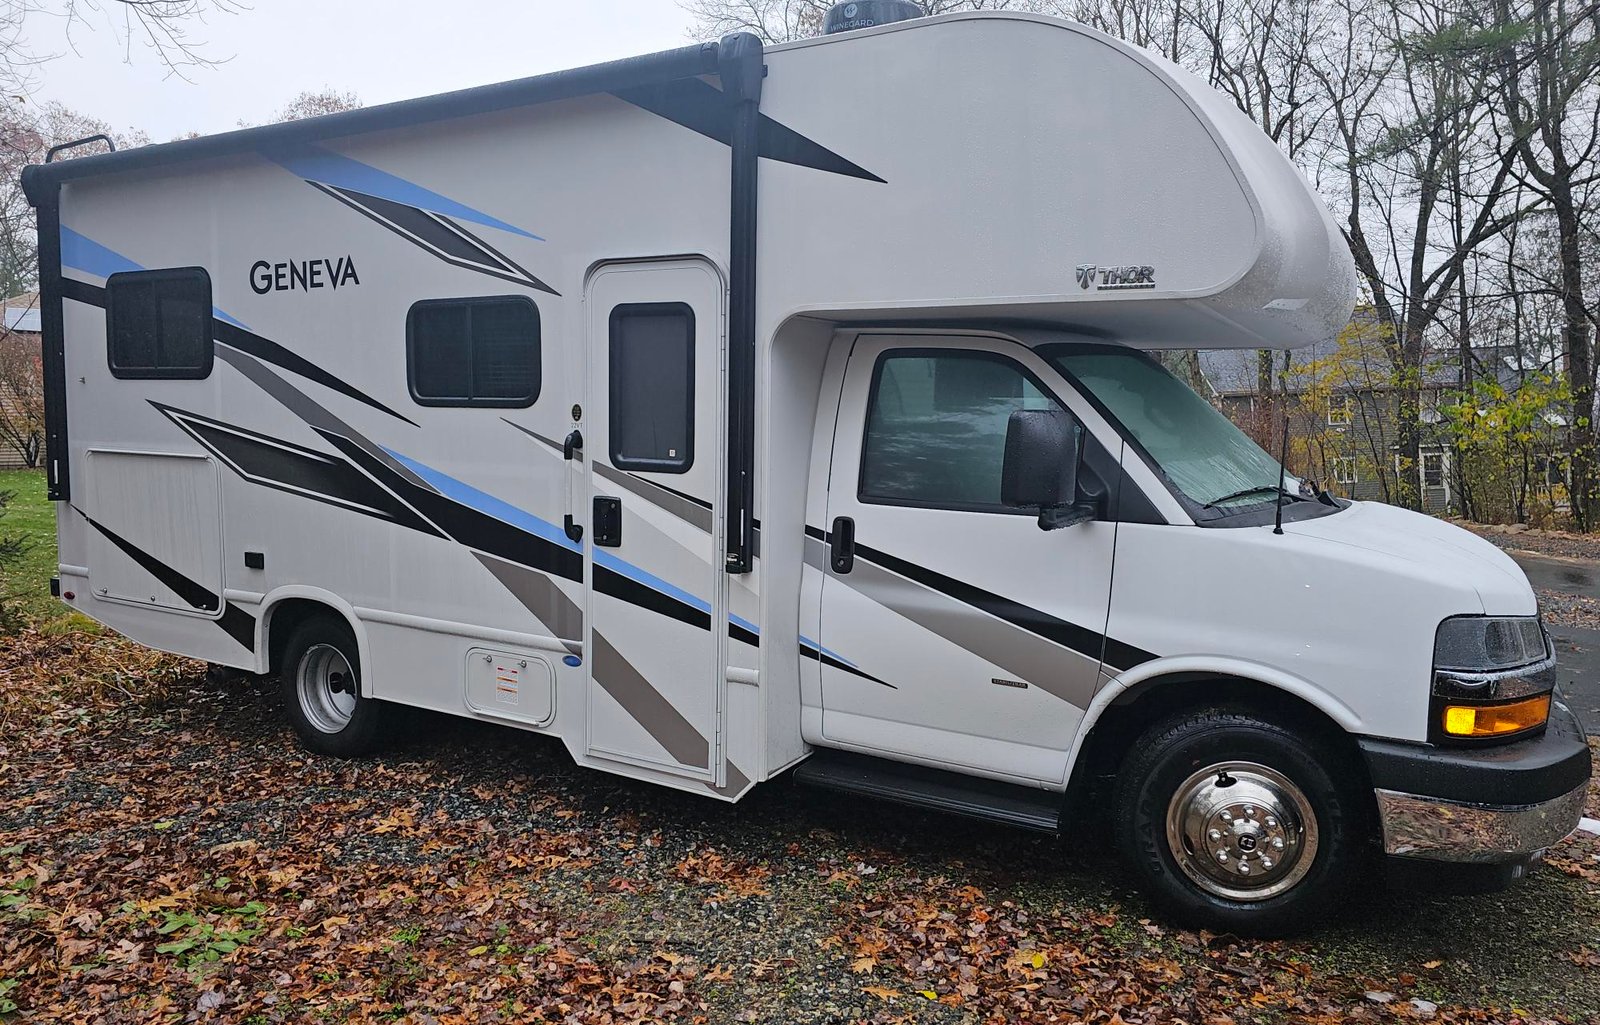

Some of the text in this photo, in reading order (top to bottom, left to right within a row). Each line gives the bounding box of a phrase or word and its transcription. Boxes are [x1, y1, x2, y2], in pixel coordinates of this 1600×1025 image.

[830, 19, 874, 32] WINEGARD
[249, 254, 360, 295] GENEVA
[1098, 265, 1155, 284] THOR
